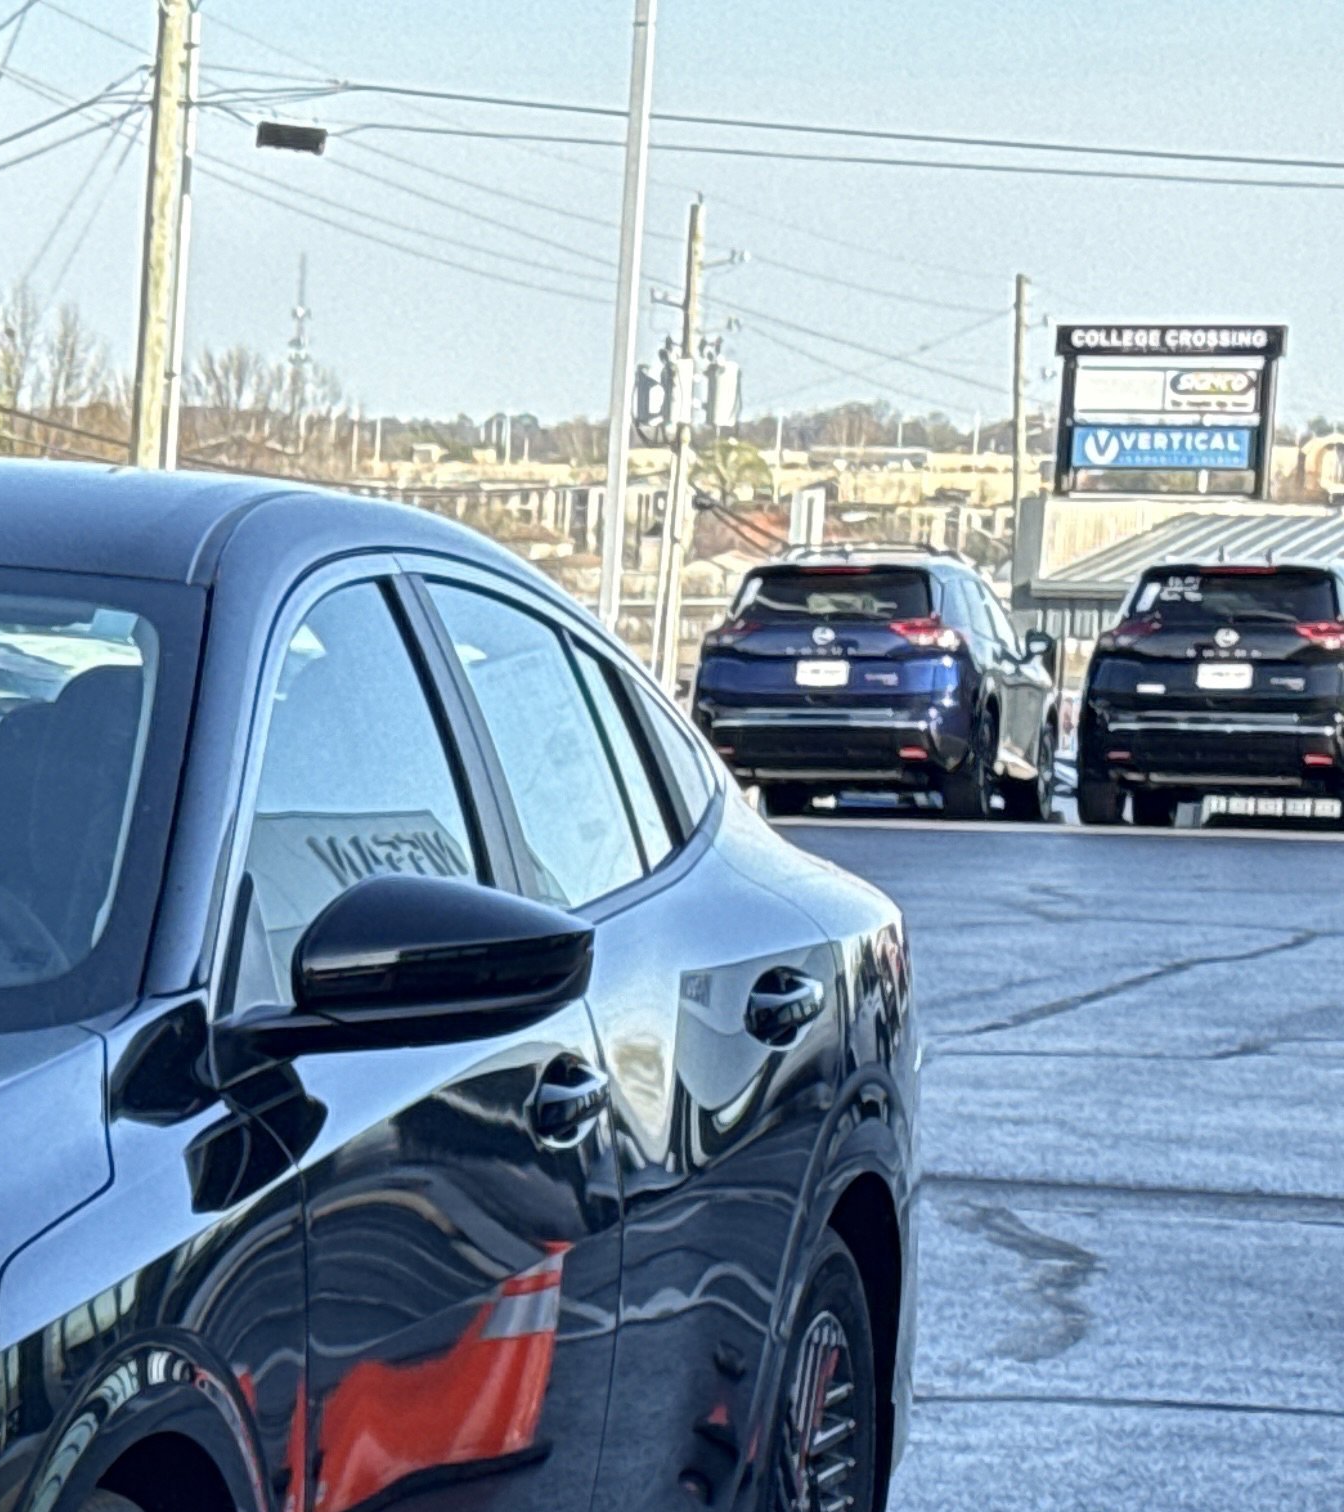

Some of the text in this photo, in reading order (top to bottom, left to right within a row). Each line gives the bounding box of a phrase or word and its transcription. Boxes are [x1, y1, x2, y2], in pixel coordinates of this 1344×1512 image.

[1071, 329, 1268, 348] COLLEGE CROSSING
[1120, 431, 1240, 451] VERTICAL
